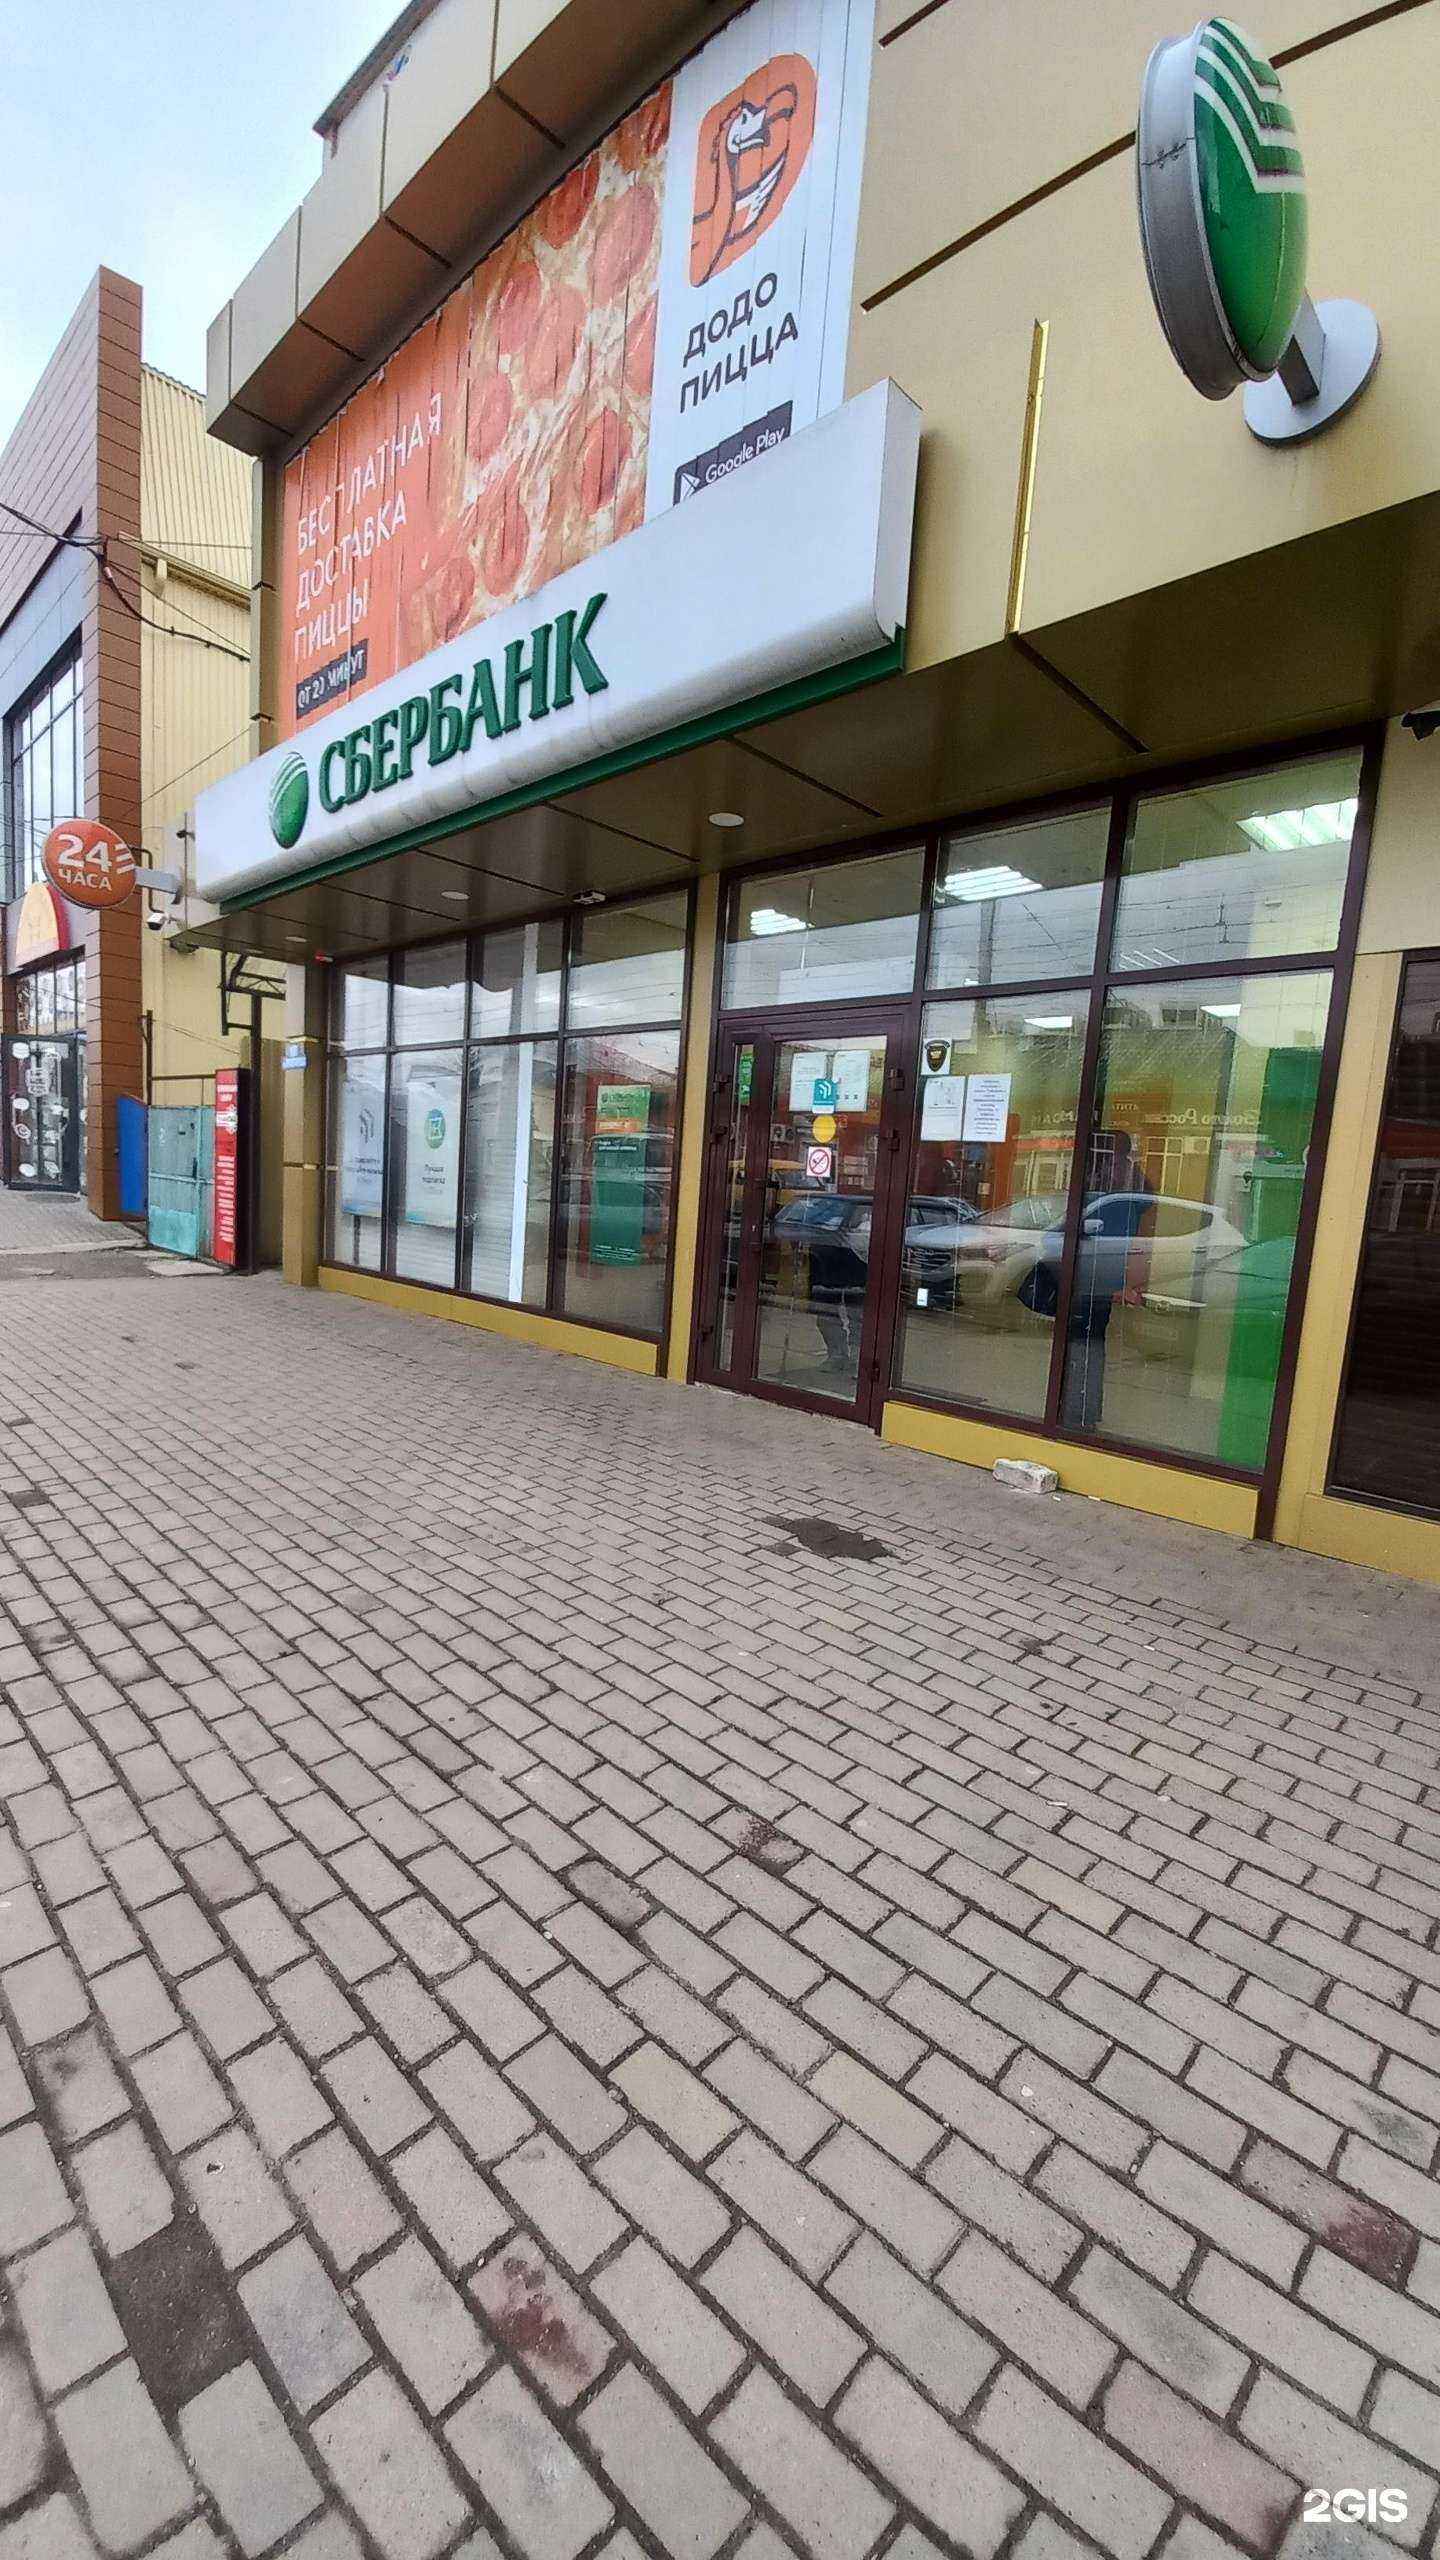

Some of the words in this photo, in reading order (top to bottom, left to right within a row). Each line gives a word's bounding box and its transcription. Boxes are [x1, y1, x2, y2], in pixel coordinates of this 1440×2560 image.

[680, 312, 799, 413] ПИЦЦА
[682, 272, 778, 368] ДОДО
[755, 426, 785, 454] Play
[295, 489, 407, 618] ДОСТАВКА
[295, 578, 368, 662] ПИЦЦЫ
[318, 592, 608, 814] СБЕРБАНК
[58, 833, 112, 873] 24
[58, 868, 112, 891] ЧАСА
